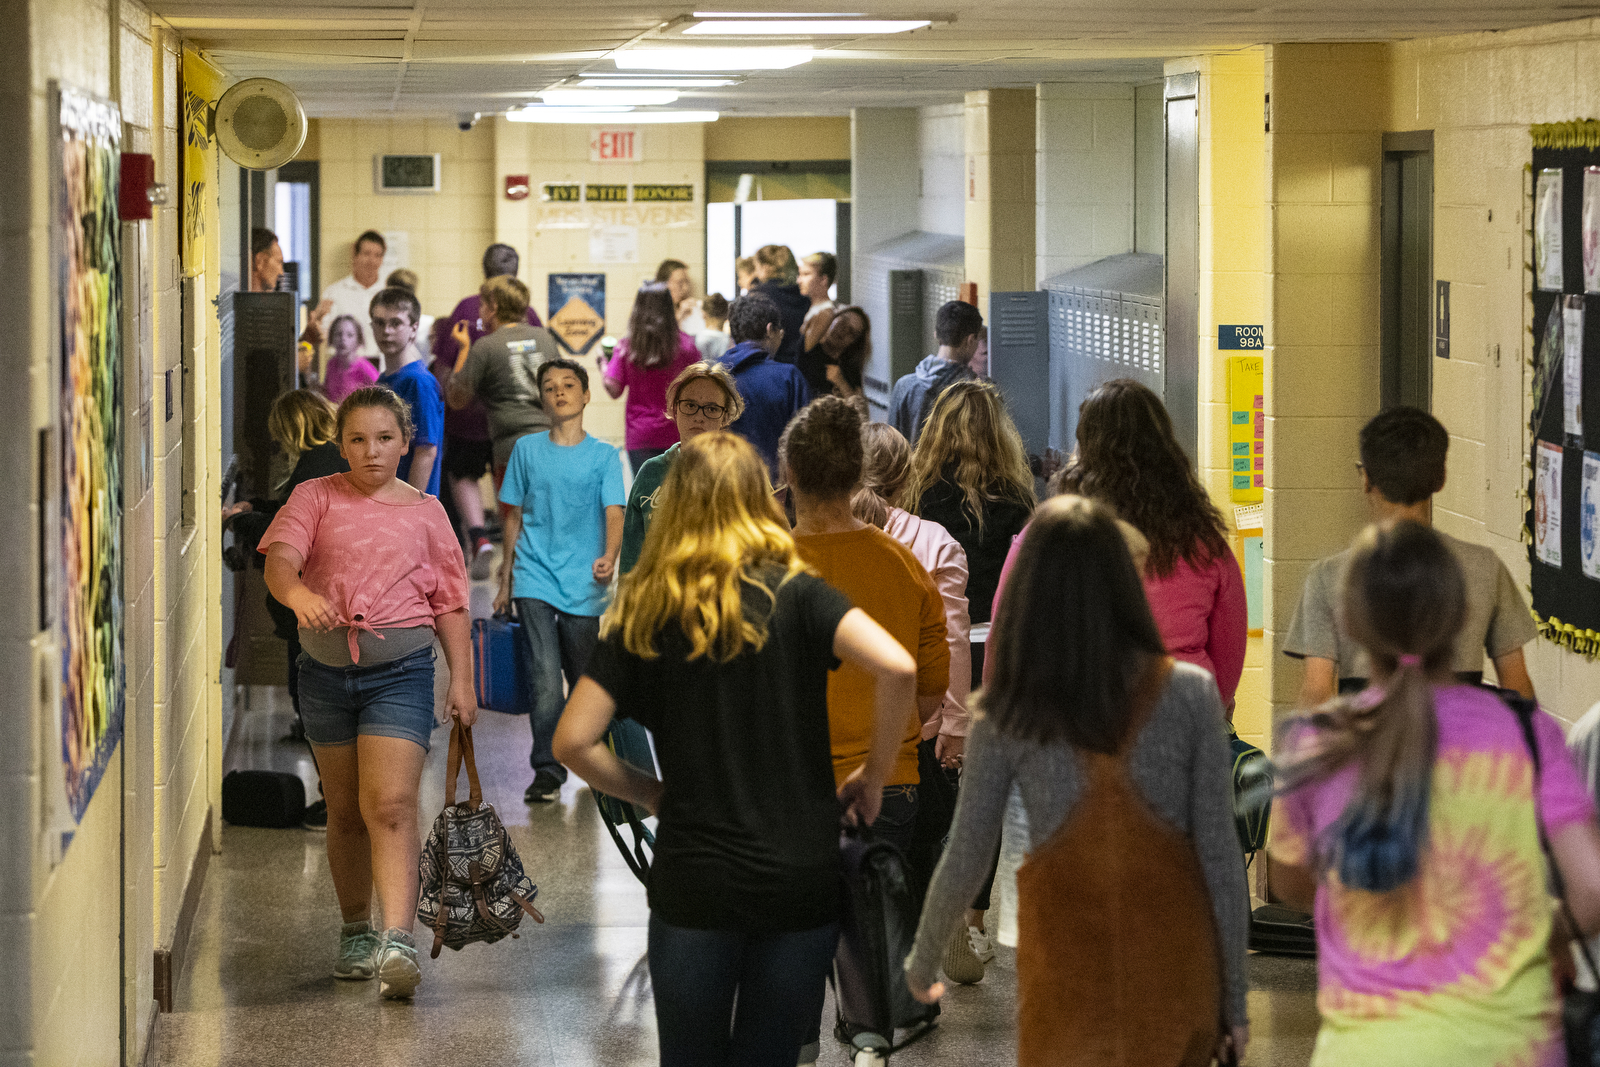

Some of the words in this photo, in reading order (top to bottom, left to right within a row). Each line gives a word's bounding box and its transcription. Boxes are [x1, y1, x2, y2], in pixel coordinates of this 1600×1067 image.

[600, 131, 634, 159] EXIT
[1239, 337, 1263, 348] 98A
[1236, 358, 1260, 373] TAKE
